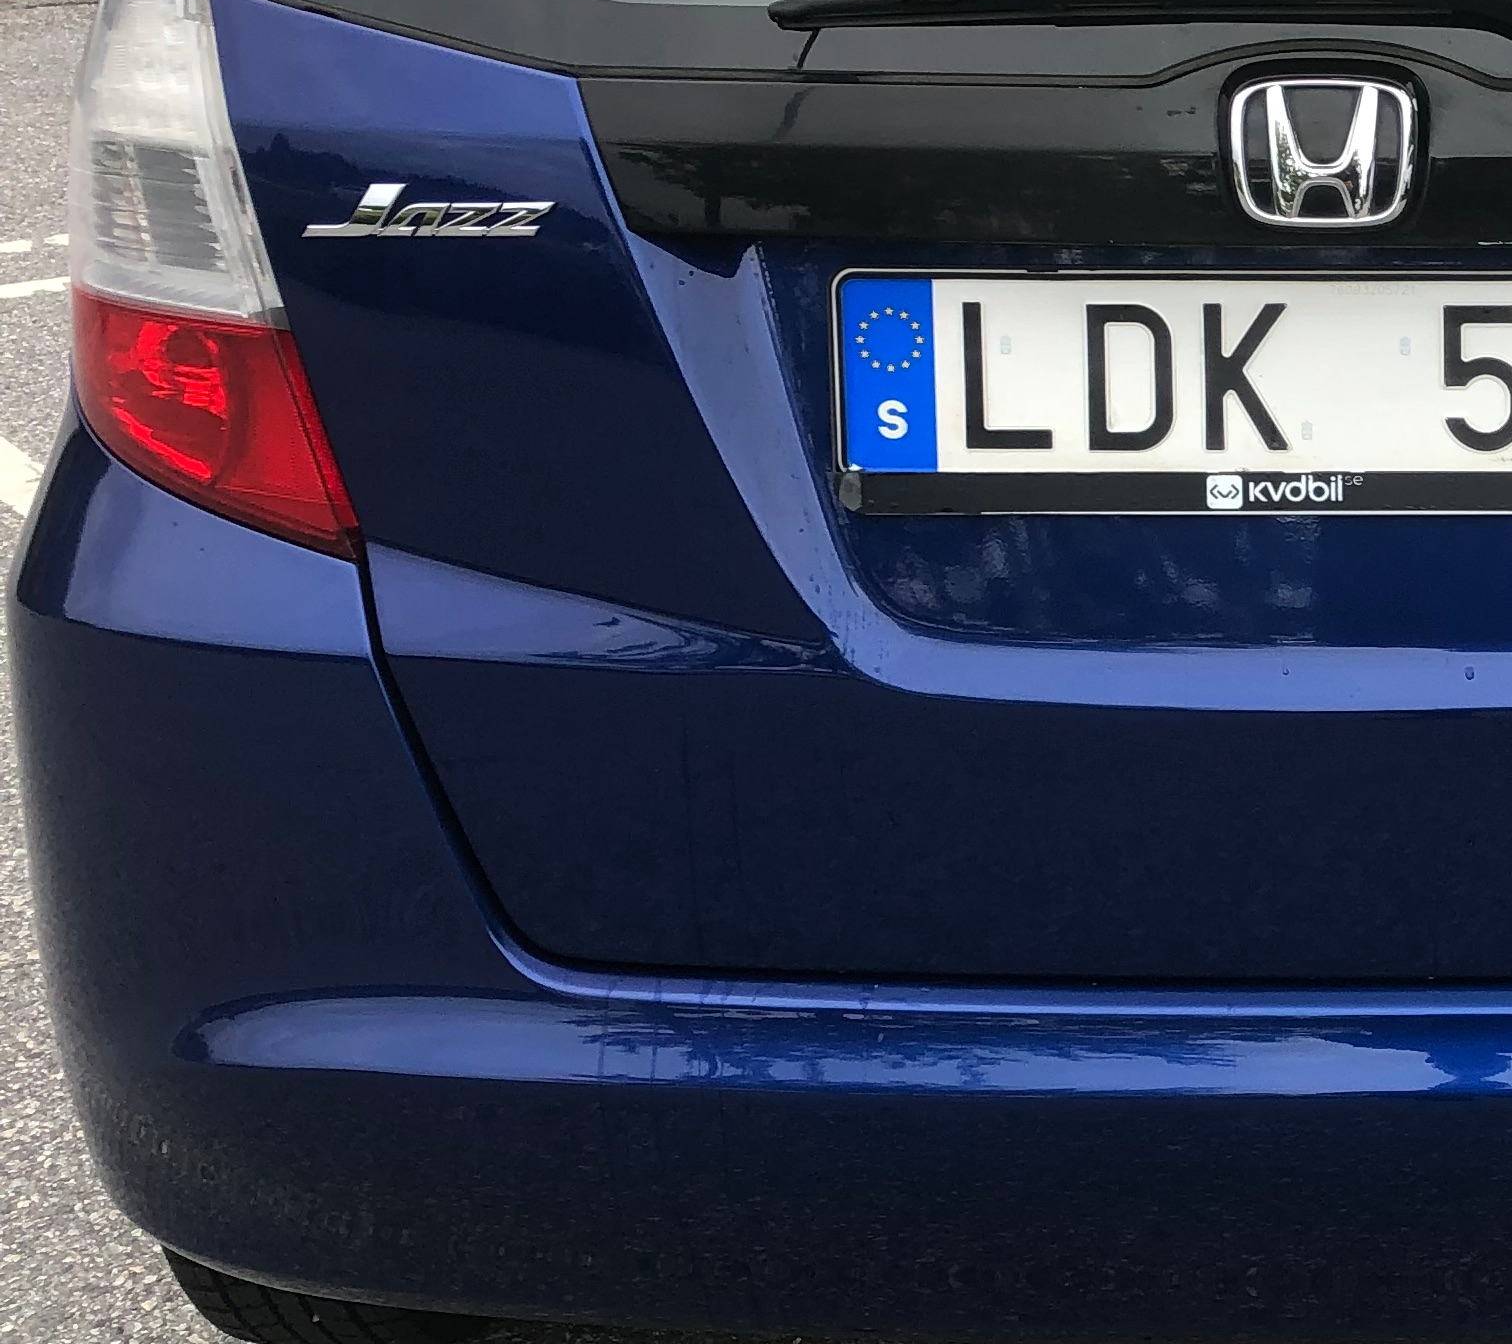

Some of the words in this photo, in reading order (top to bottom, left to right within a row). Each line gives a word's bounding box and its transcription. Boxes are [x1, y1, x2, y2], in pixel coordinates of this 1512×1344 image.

[301, 183, 556, 237] Jazz
[961, 301, 1290, 452] LDK
[876, 399, 909, 440] S
